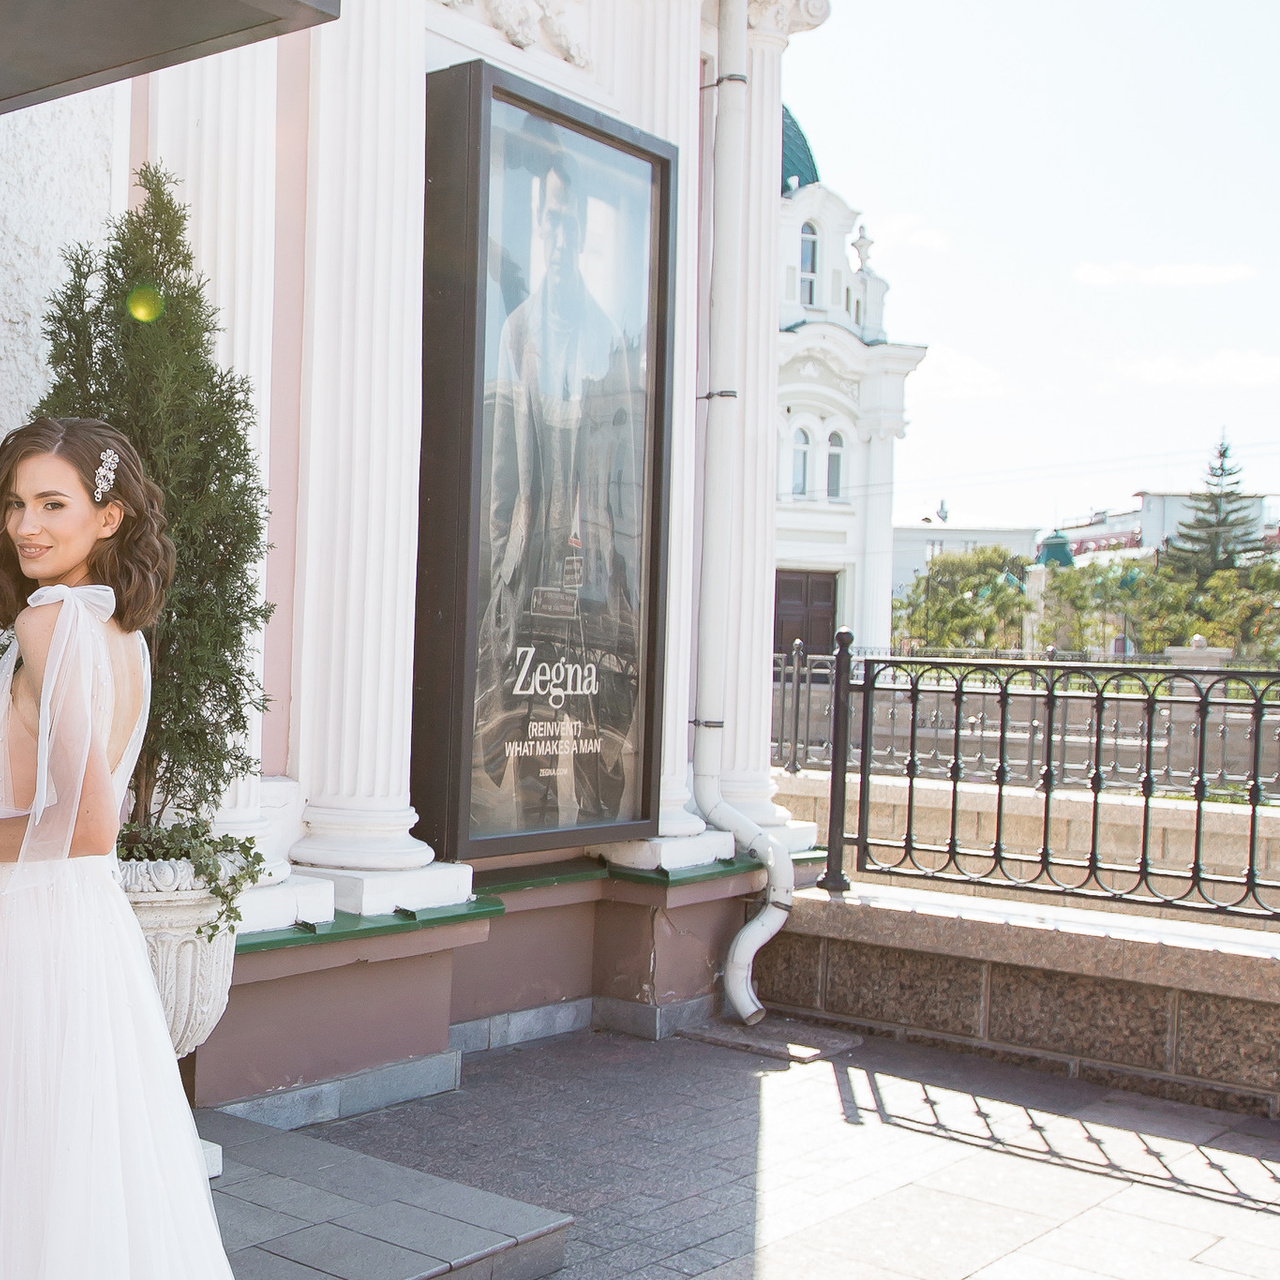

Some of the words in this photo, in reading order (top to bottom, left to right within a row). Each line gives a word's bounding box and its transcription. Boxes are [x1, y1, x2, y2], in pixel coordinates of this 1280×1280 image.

[512, 646, 599, 709] Zegna
[528, 720, 582, 738] (REINVENT)
[505, 741, 535, 757] WHAT
[536, 740, 570, 755] MAKES
[571, 740, 578, 754] A
[580, 738, 601, 754] MAN
